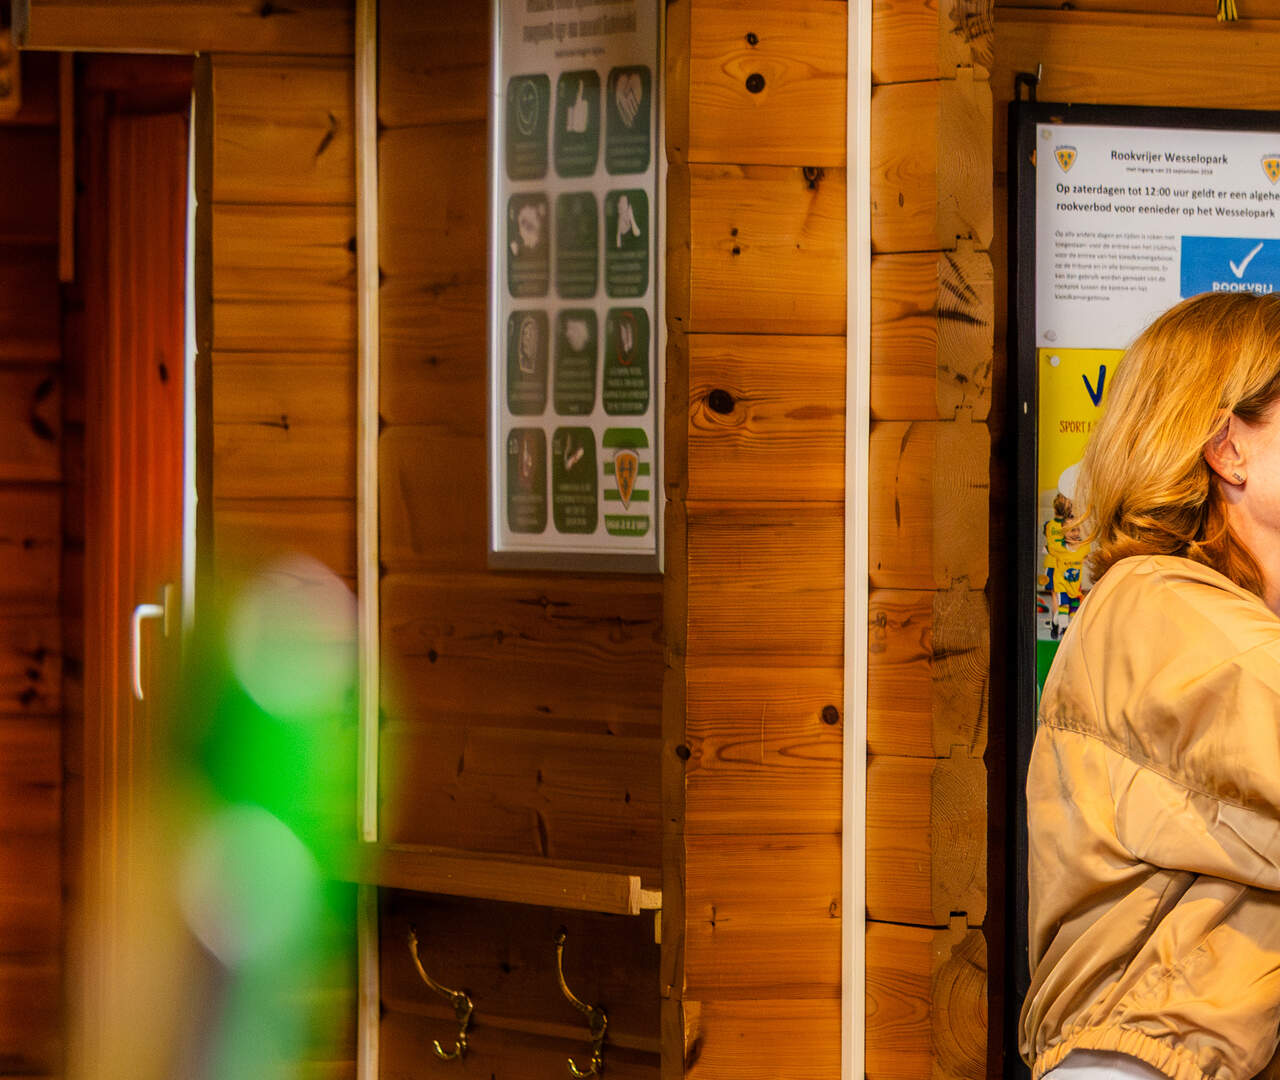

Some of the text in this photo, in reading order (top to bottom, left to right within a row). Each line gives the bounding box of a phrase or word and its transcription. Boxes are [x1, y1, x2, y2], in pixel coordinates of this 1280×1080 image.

[1110, 150, 1228, 165] Rookvrijer Wesselopark
[1056, 183, 1070, 195] Op
[1073, 184, 1126, 197] zaterdagen
[1128, 186, 1142, 196] tot
[1145, 187, 1171, 197] 12:00
[1173, 188, 1189, 198] uur
[1191, 188, 1215, 200] geldt
[1217, 190, 1228, 199] er
[1229, 191, 1247, 200] een
[1056, 200, 1276, 219] rookverbod voor eenieder op het Wesselopark
[1060, 420, 1086, 433] SPORT
